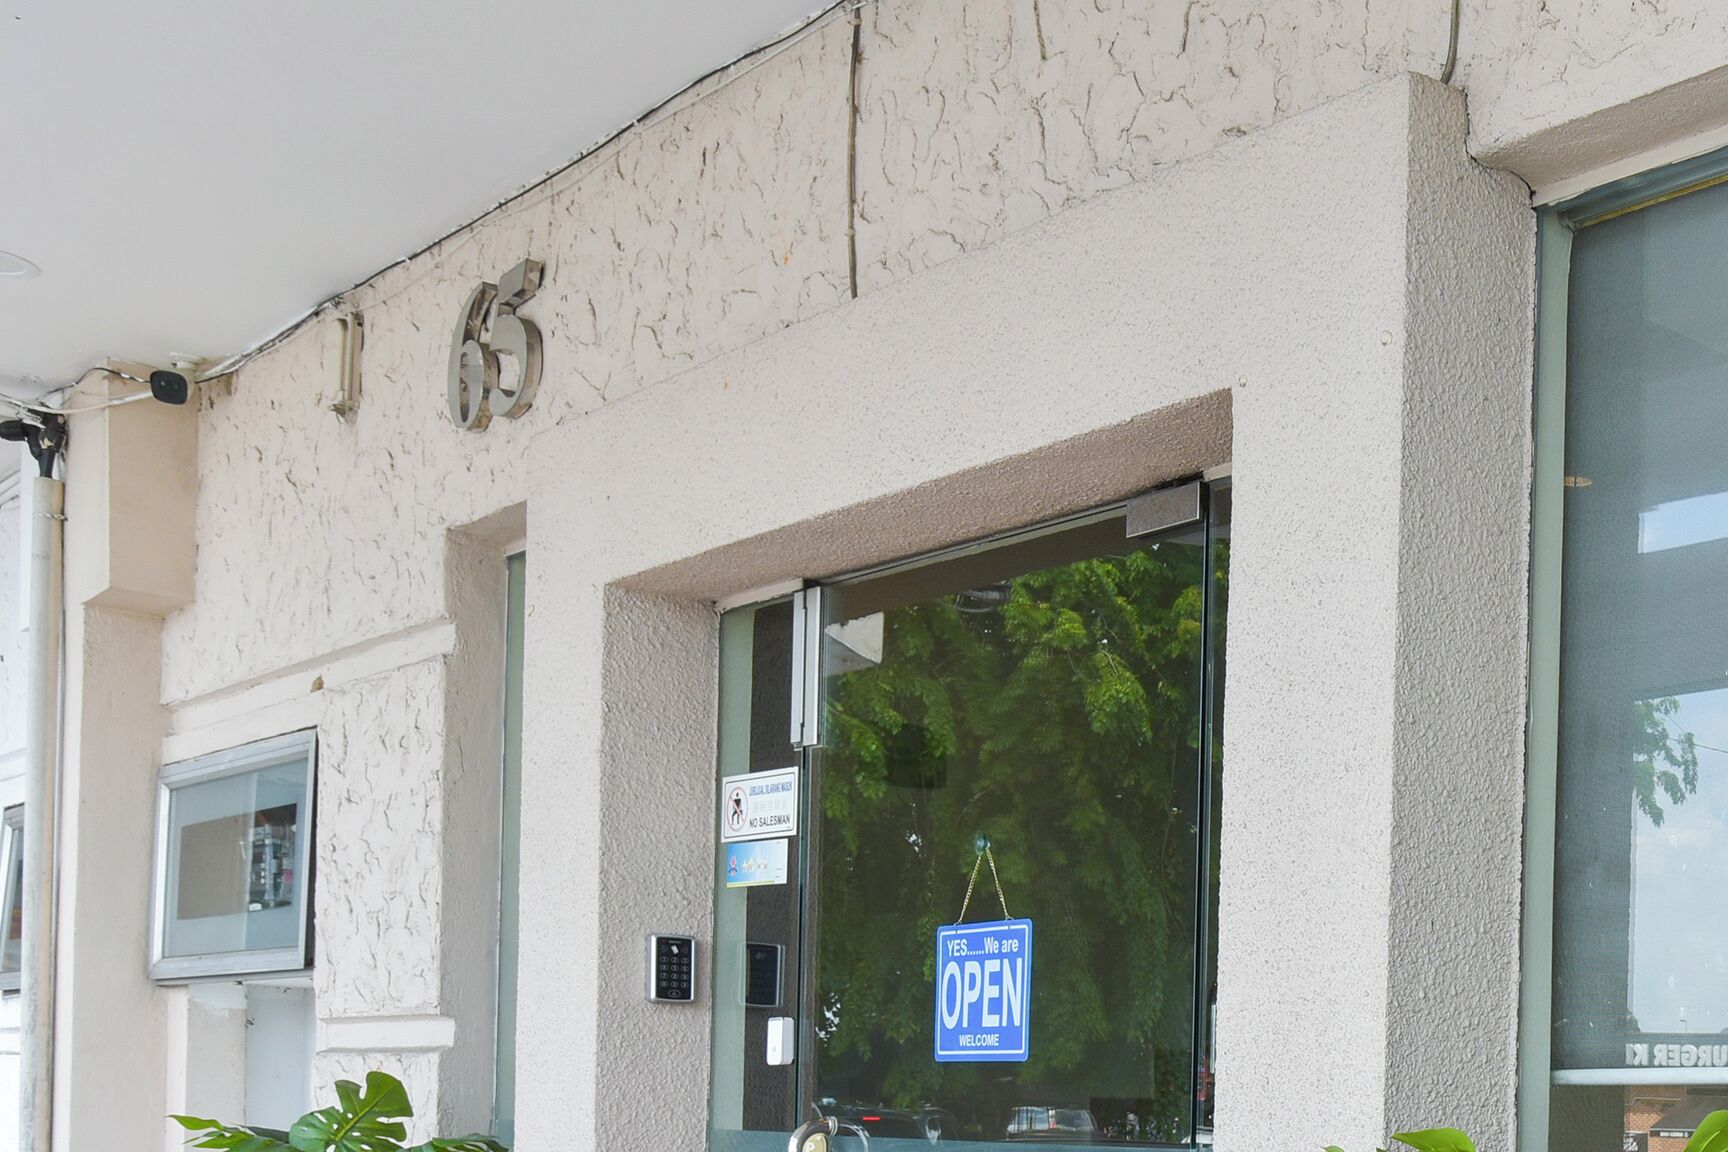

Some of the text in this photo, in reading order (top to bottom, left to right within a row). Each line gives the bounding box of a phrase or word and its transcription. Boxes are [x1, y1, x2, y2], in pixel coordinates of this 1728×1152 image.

[447, 258, 544, 432] 65
[749, 814, 791, 828] NO SALESMAN
[1002, 938, 1019, 953] are
[941, 958, 1022, 1029] OPEN
[959, 1034, 999, 1046] WELCOME
